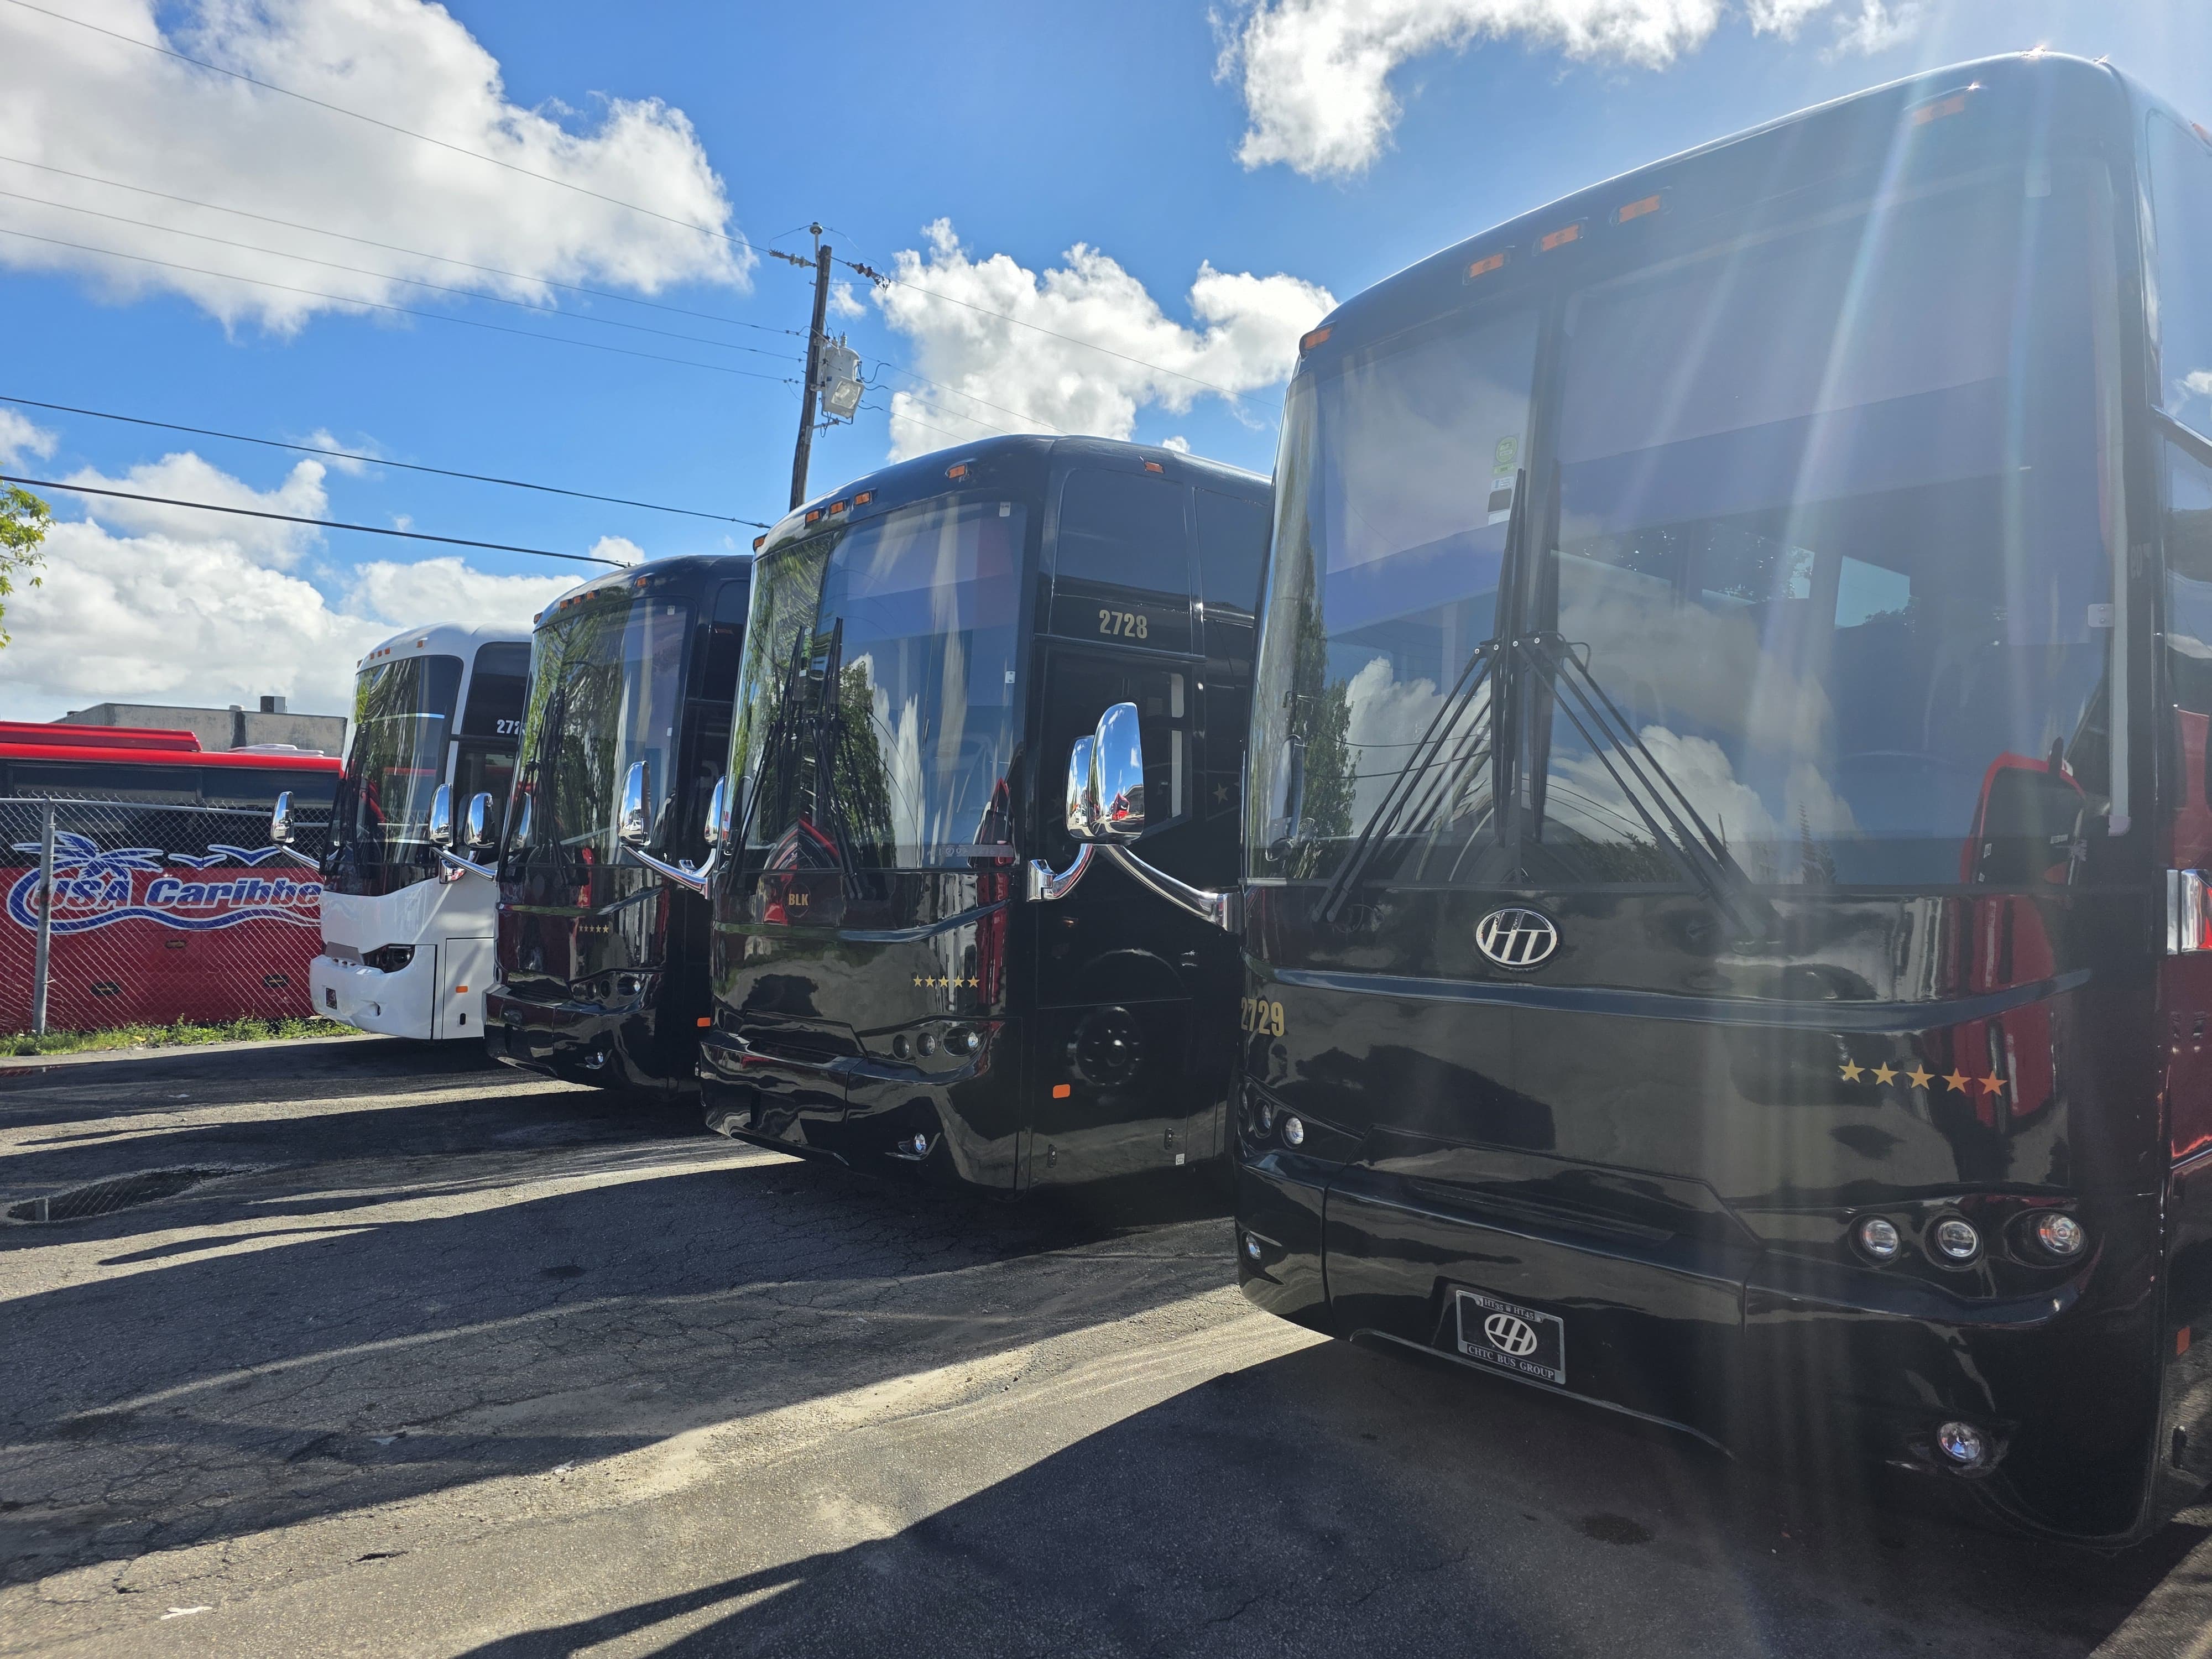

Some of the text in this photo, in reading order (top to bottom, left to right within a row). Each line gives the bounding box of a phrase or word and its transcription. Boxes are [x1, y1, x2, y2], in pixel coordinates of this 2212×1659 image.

[1099, 609, 1147, 639] 2728
[497, 719, 520, 735] 272
[30, 877, 324, 910] USA Caribbe
[788, 893, 809, 906] BLK
[1240, 997, 1285, 1037] 2729
[1484, 1298, 1535, 1320] HT35 HT45
[1468, 1345, 1554, 1379] CHTC BUS GROUP
